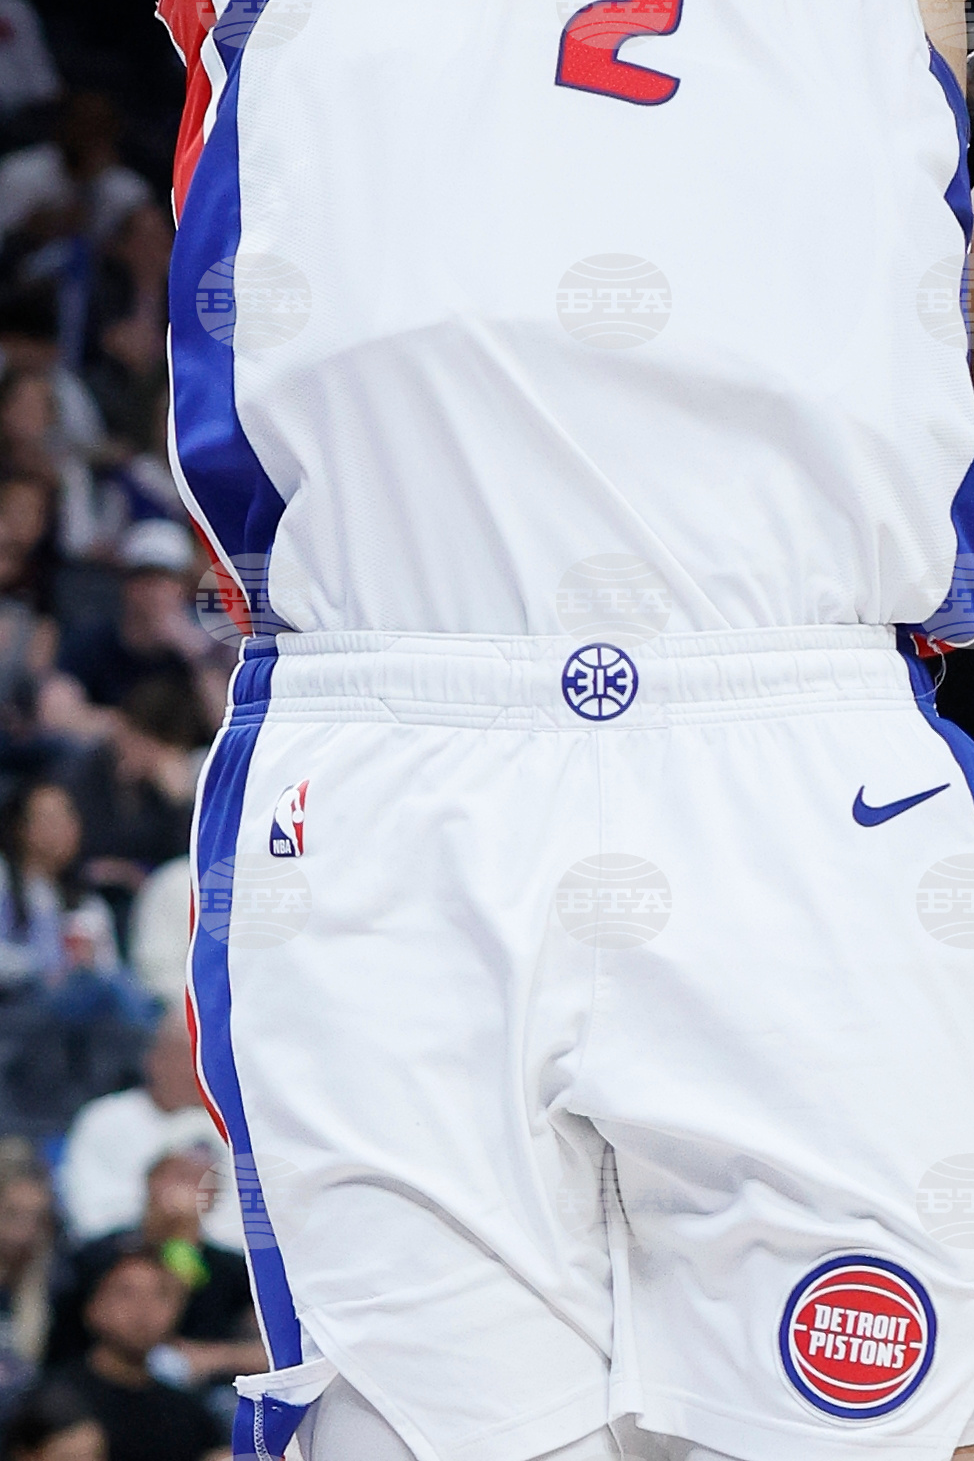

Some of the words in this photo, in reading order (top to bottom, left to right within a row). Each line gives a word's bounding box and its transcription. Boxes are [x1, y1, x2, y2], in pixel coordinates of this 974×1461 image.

[272, 838, 292, 855] NBA
[814, 1303, 911, 1342] DETROIT
[808, 1330, 907, 1369] PISTONS
